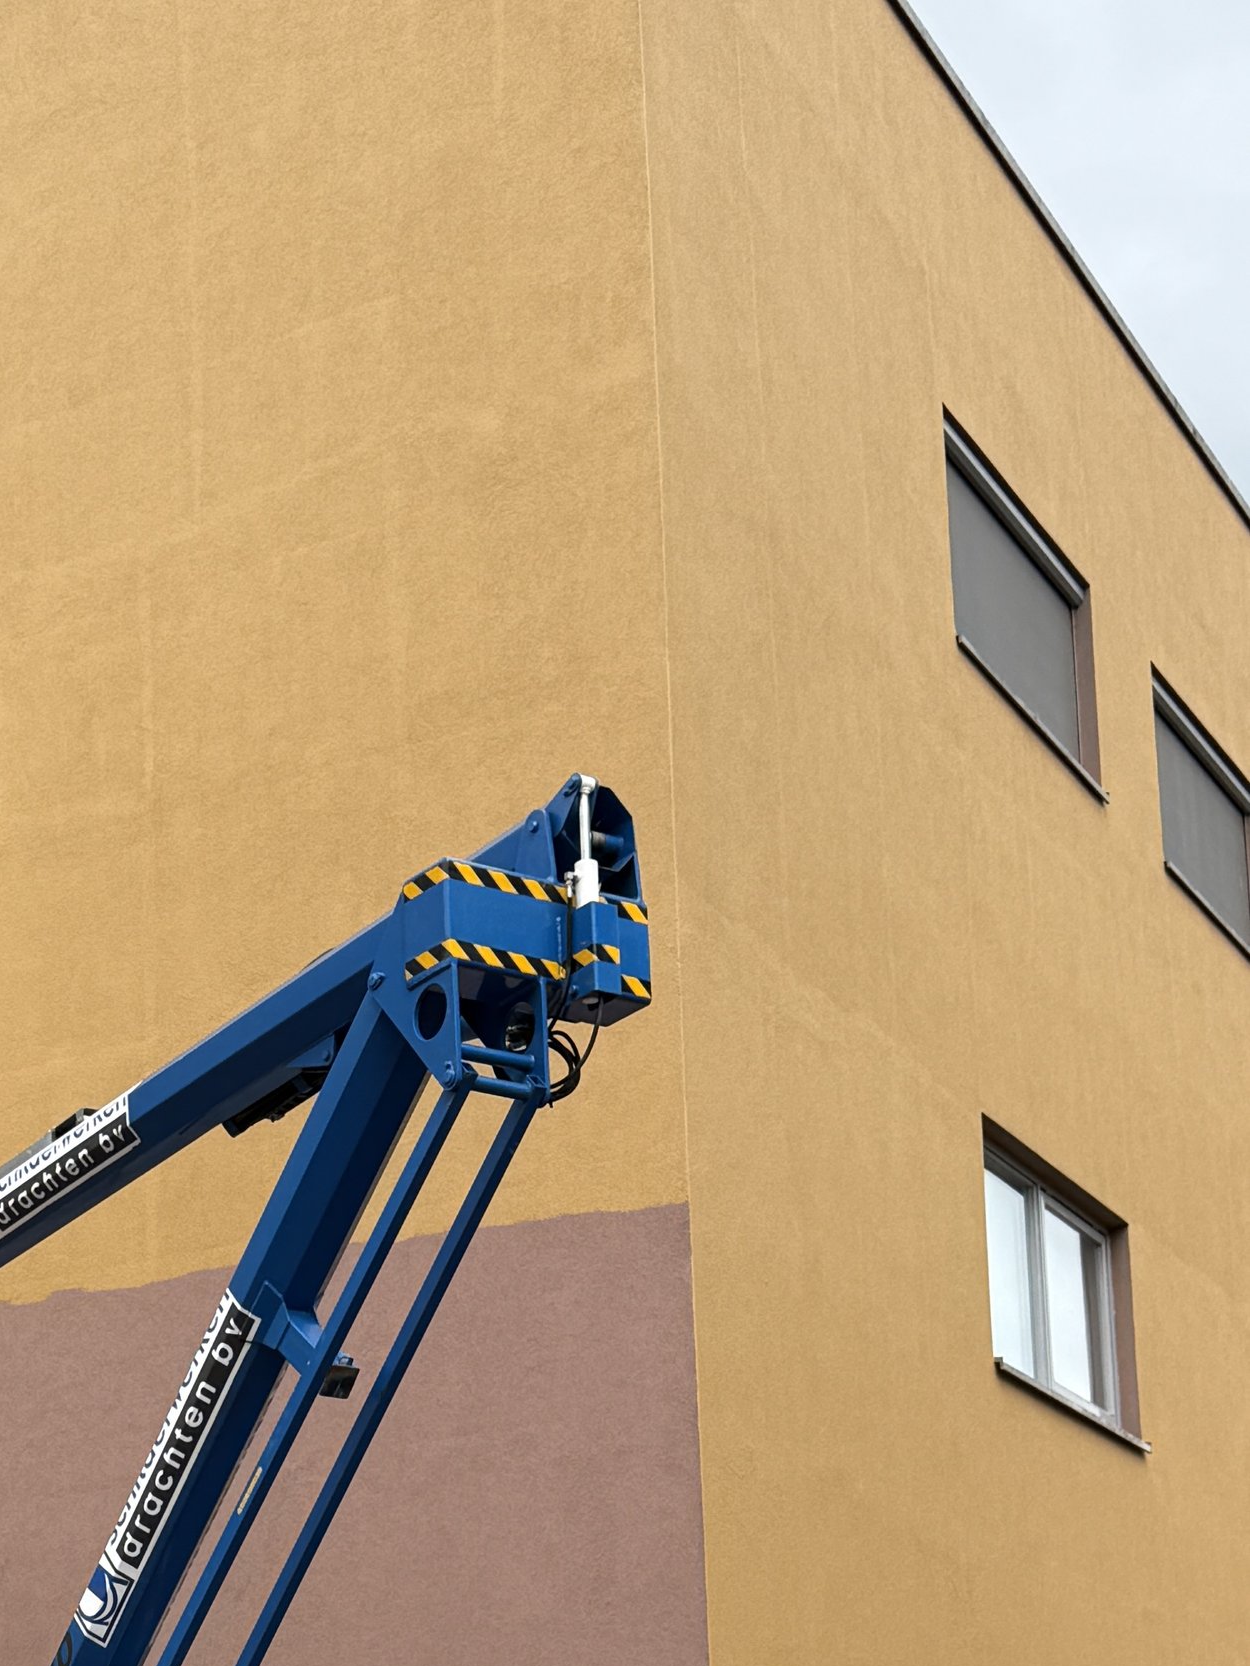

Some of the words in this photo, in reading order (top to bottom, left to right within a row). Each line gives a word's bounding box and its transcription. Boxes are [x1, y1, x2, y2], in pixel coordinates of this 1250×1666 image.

[98, 1123, 126, 1154] bv
[123, 1380, 217, 1558] drachten
[211, 1317, 243, 1367] bv
